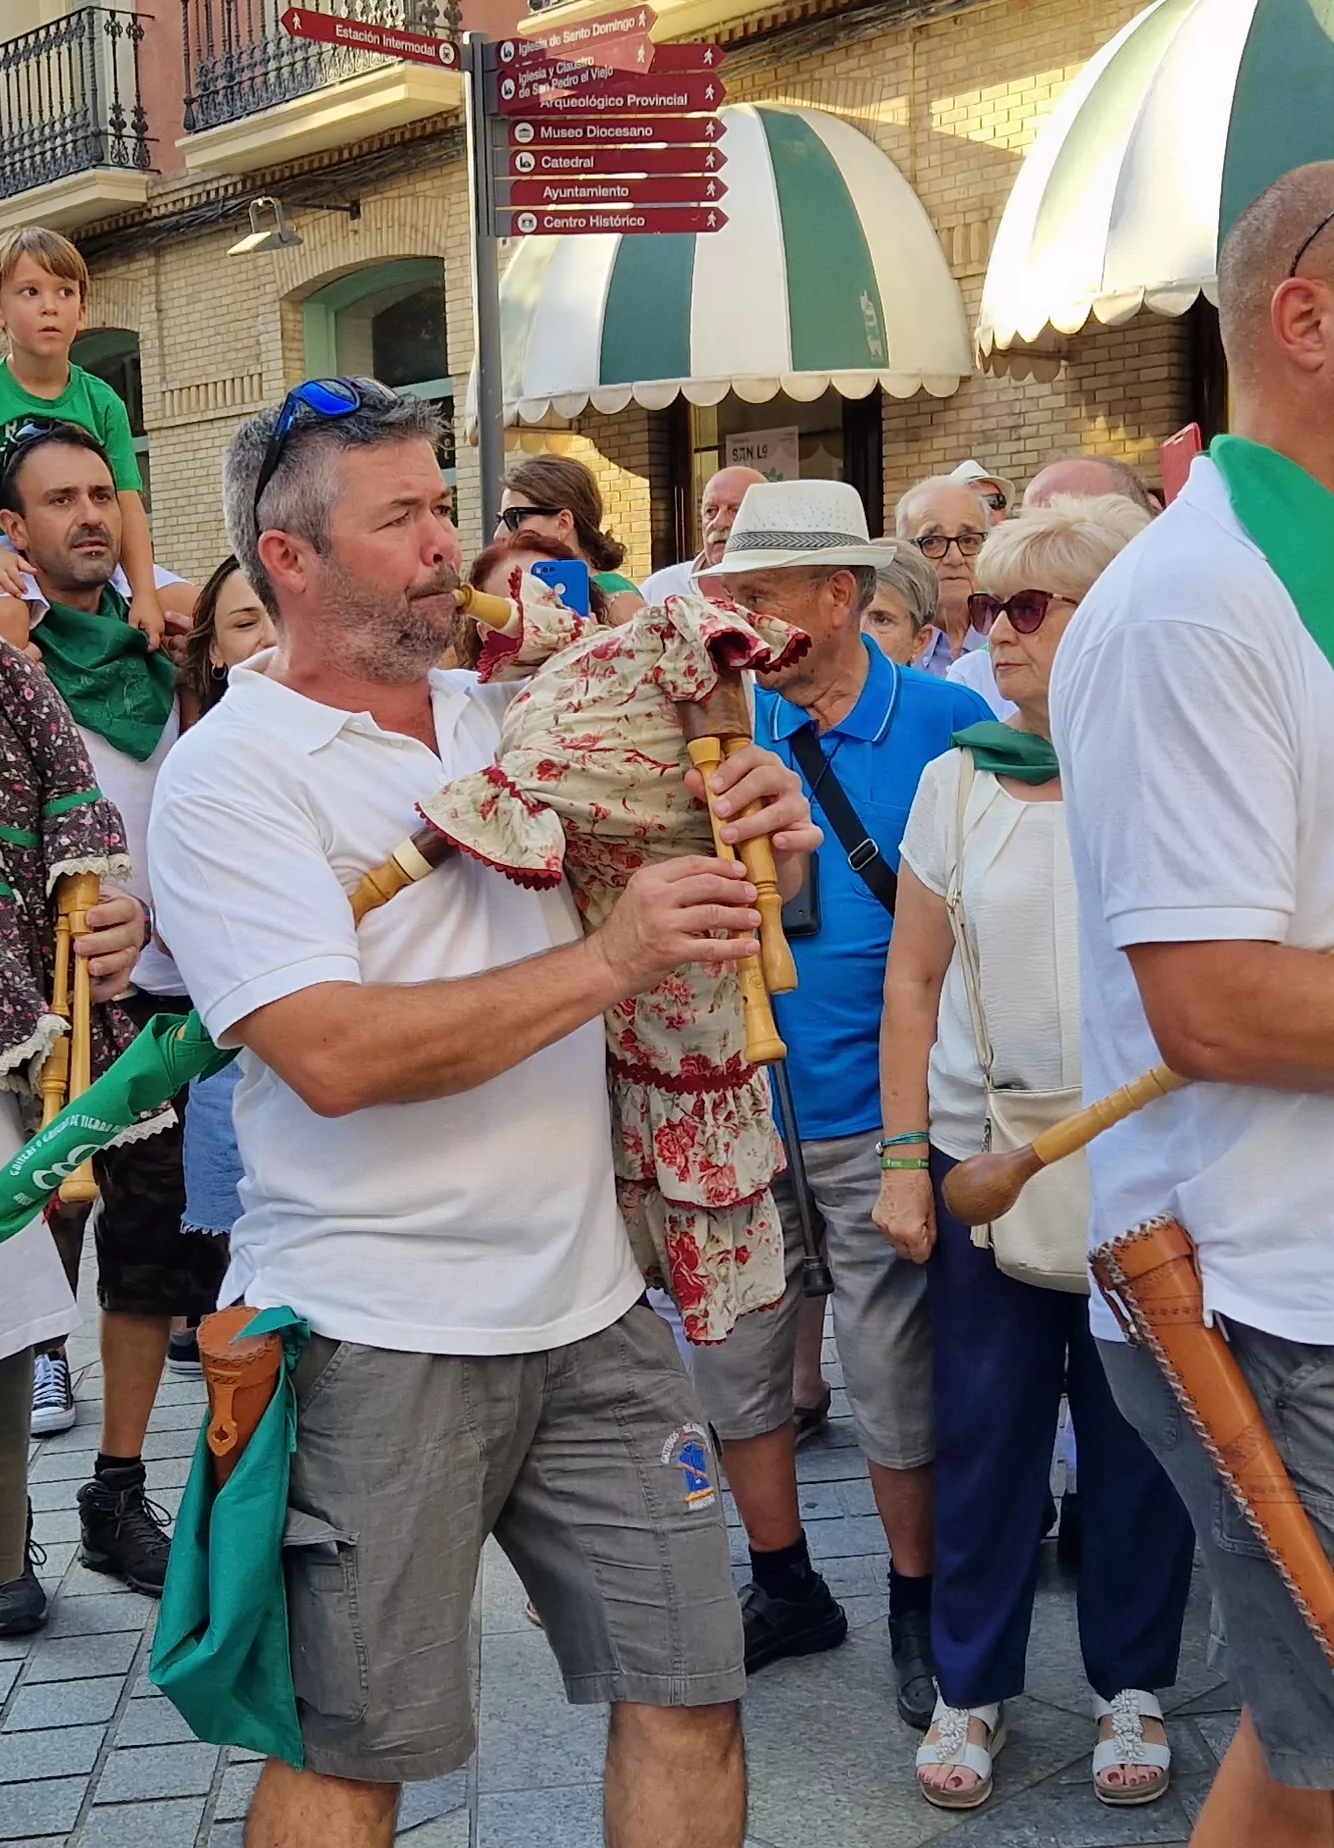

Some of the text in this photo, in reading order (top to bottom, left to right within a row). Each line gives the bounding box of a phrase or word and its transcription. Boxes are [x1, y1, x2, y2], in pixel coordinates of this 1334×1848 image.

[335, 24, 436, 57] Estación Intermodal
[518, 18, 636, 57] Iglesia de Santo Domingo
[518, 55, 595, 87] Iglesia y Claustro
[518, 67, 614, 99] de San Pedro el Viejo
[540, 93, 688, 110] Arqueológico Provincial
[540, 125, 653, 139] Museo Diocesano
[541, 155, 594, 169] Catedral
[543, 185, 629, 200] Ayuntamiento
[543, 214, 645, 229] Centro Histórico
[732, 445, 754, 462] SAN
